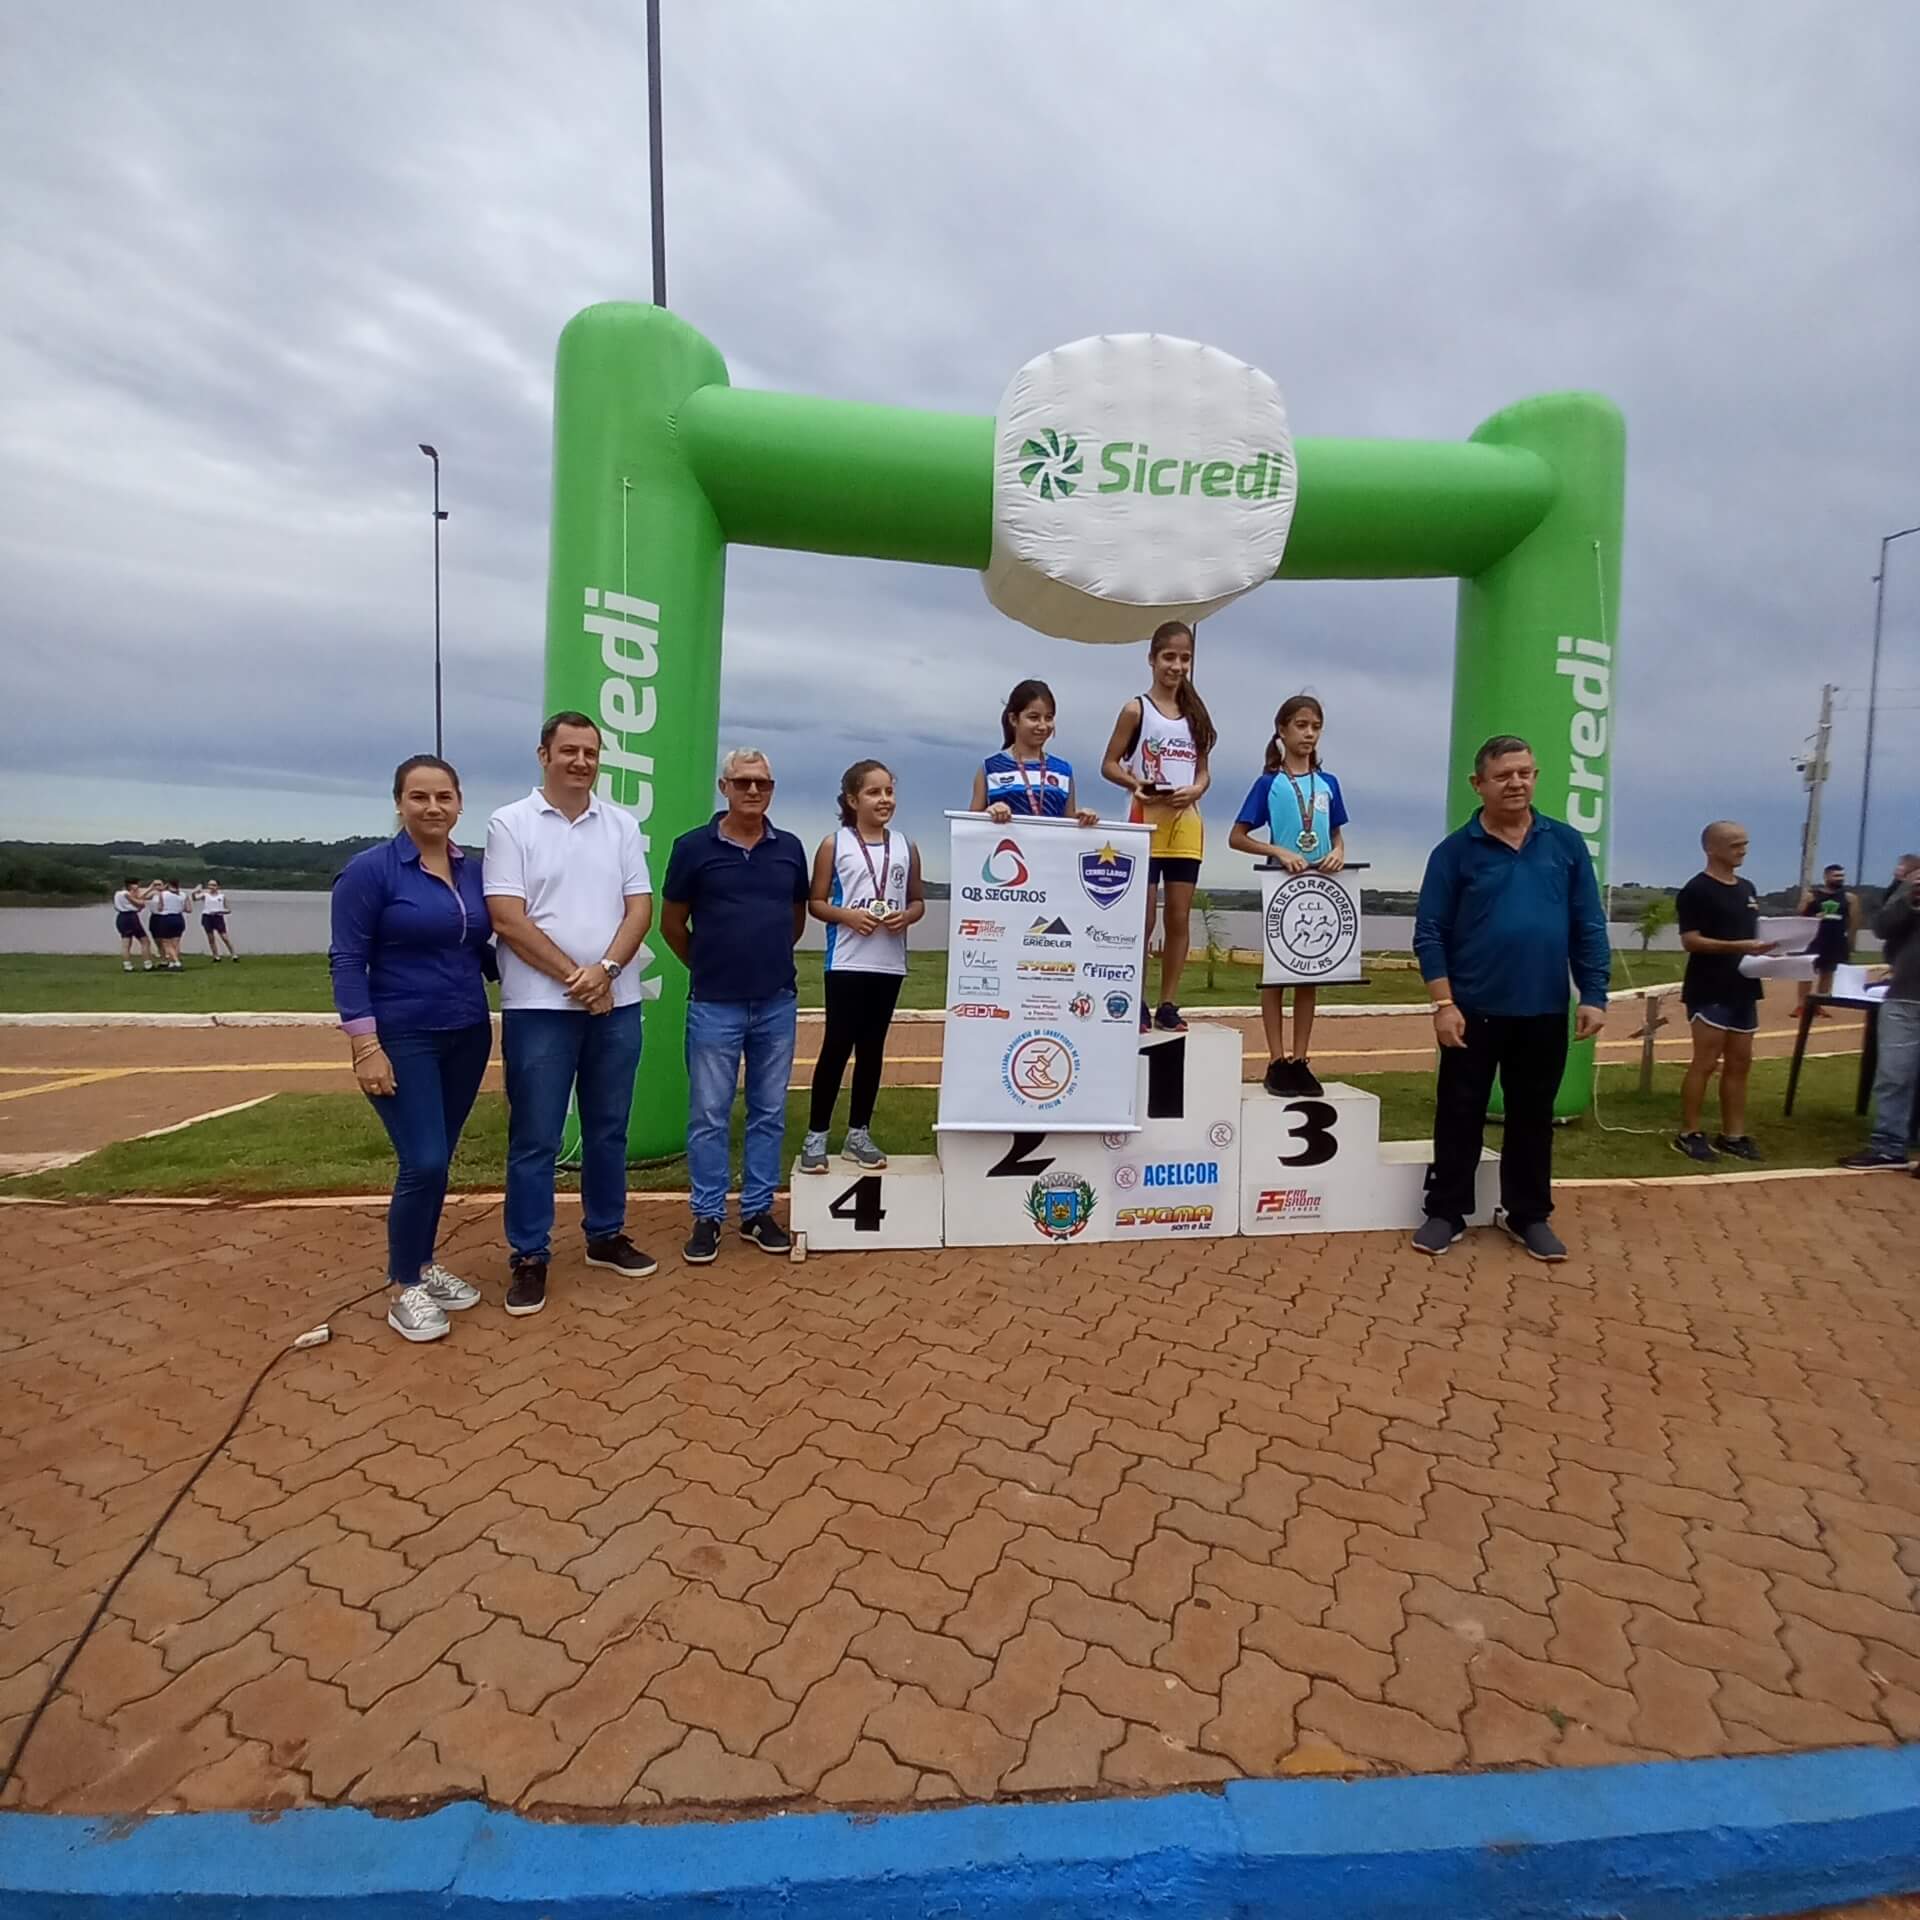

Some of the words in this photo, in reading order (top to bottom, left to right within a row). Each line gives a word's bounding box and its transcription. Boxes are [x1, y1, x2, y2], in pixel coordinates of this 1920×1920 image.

[1098, 441, 1284, 500] Sicredi
[961, 886, 983, 902] QR
[984, 887, 1047, 904] SEGUROS
[1274, 890, 1291, 907] DE
[1288, 879, 1351, 922] CORREDORES
[1268, 906, 1282, 939] CLUBE
[1341, 922, 1354, 937] DE
[1023, 938, 1072, 949] GRIEDELER
[1318, 956, 1334, 970] RS
[1138, 1035, 1187, 1119] 1
[1277, 1100, 1339, 1168] 3
[1143, 1162, 1219, 1187] ACELCOR
[828, 1175, 887, 1232] 4
[1115, 1204, 1214, 1226] SYGMA
